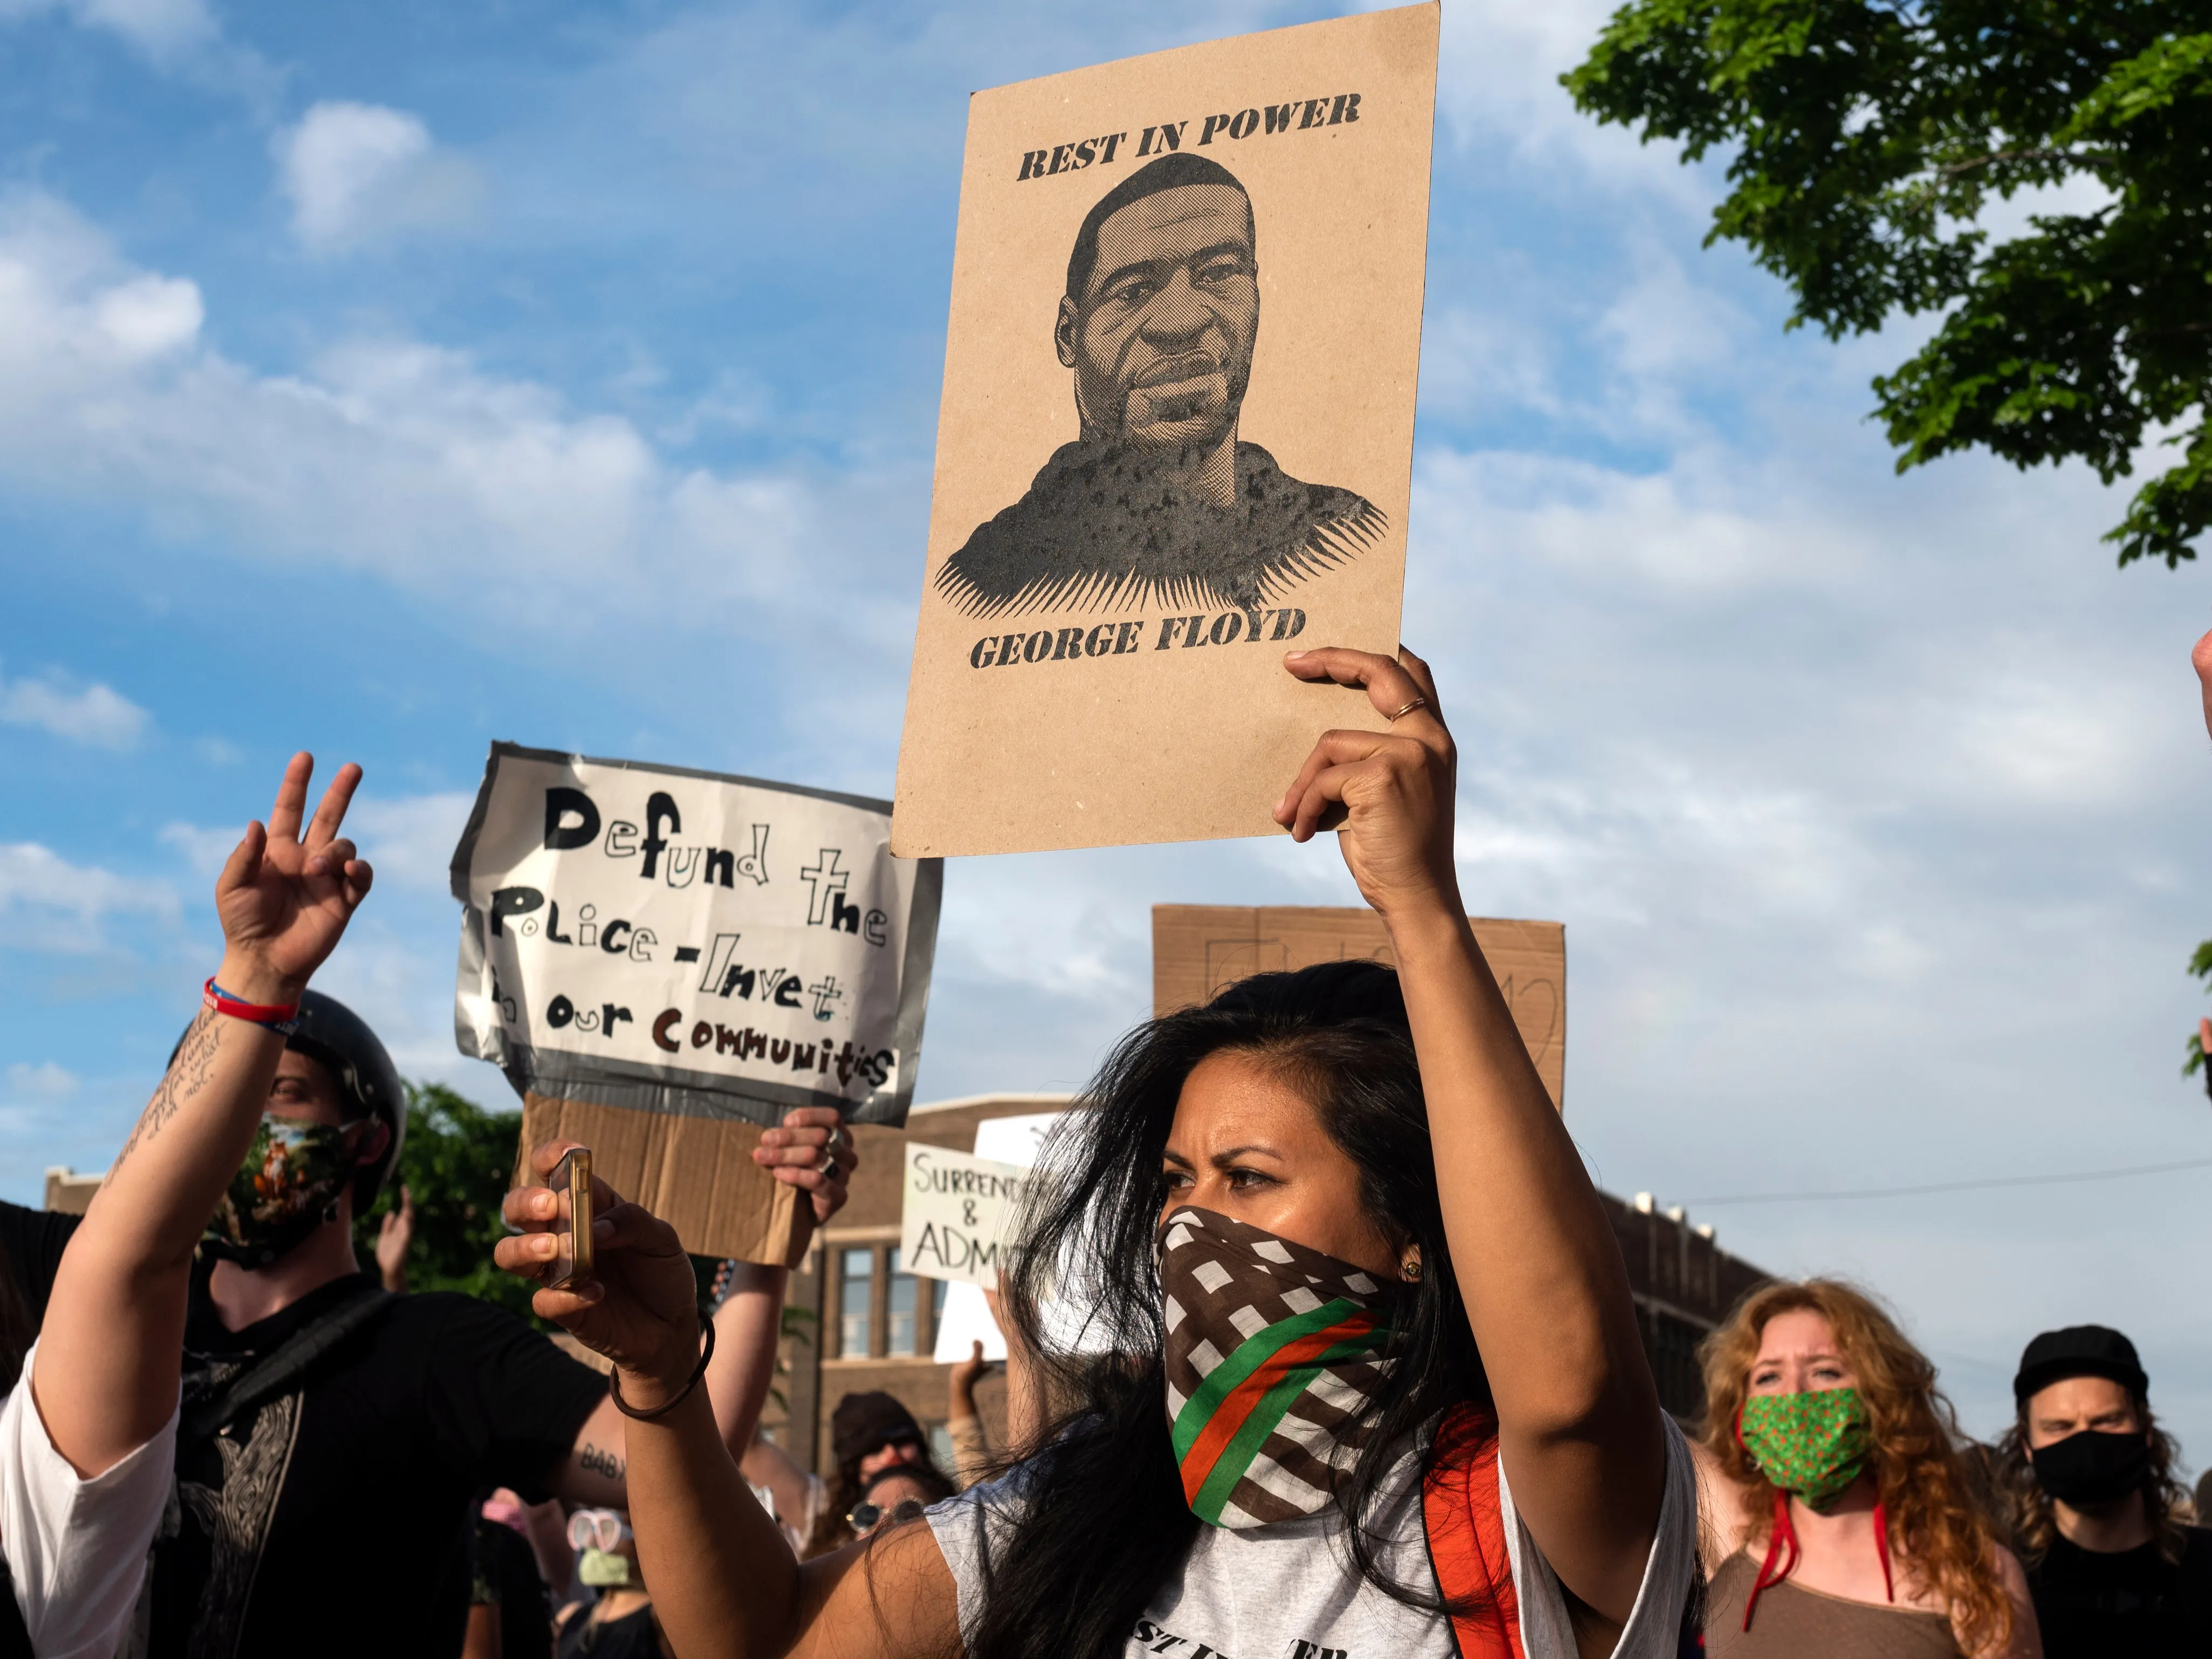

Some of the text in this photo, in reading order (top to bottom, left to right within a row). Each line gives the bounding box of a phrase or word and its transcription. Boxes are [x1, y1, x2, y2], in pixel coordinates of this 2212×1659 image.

[1016, 93, 1362, 182] REST IN POWER
[970, 607, 1306, 669] GEORGE FLOYD
[544, 787, 888, 948] Defund the
[913, 1152, 1028, 1205] SURREND
[962, 1198, 978, 1227] &
[911, 1221, 999, 1277] ADM
[1133, 1620, 1188, 1654] ST
